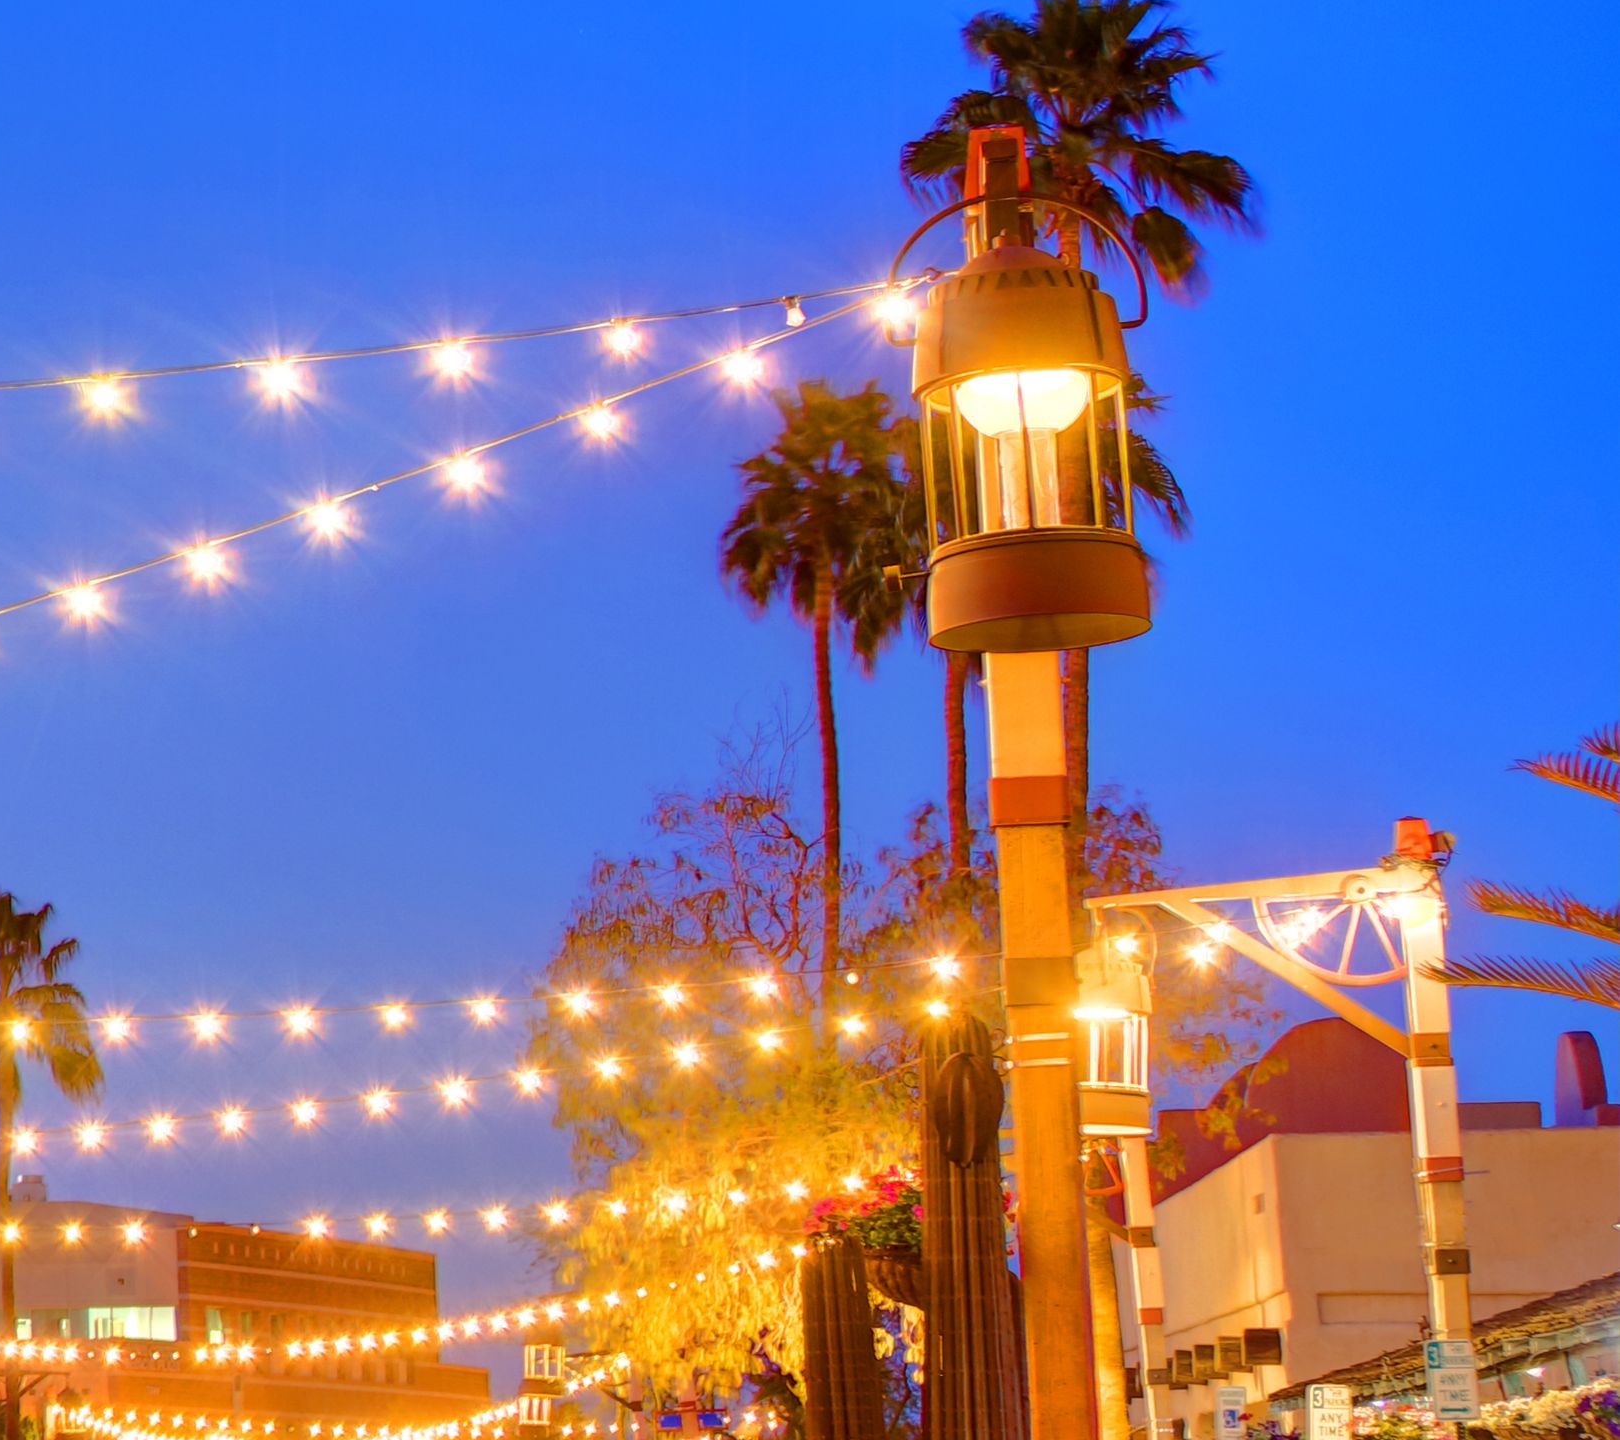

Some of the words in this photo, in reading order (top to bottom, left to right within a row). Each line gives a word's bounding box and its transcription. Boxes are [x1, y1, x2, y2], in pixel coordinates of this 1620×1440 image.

[1428, 1344, 1439, 1366] 3
[1314, 1390, 1323, 1407] 3
[1320, 1413, 1344, 1424] ANY
[1319, 1426, 1345, 1437] TIME
